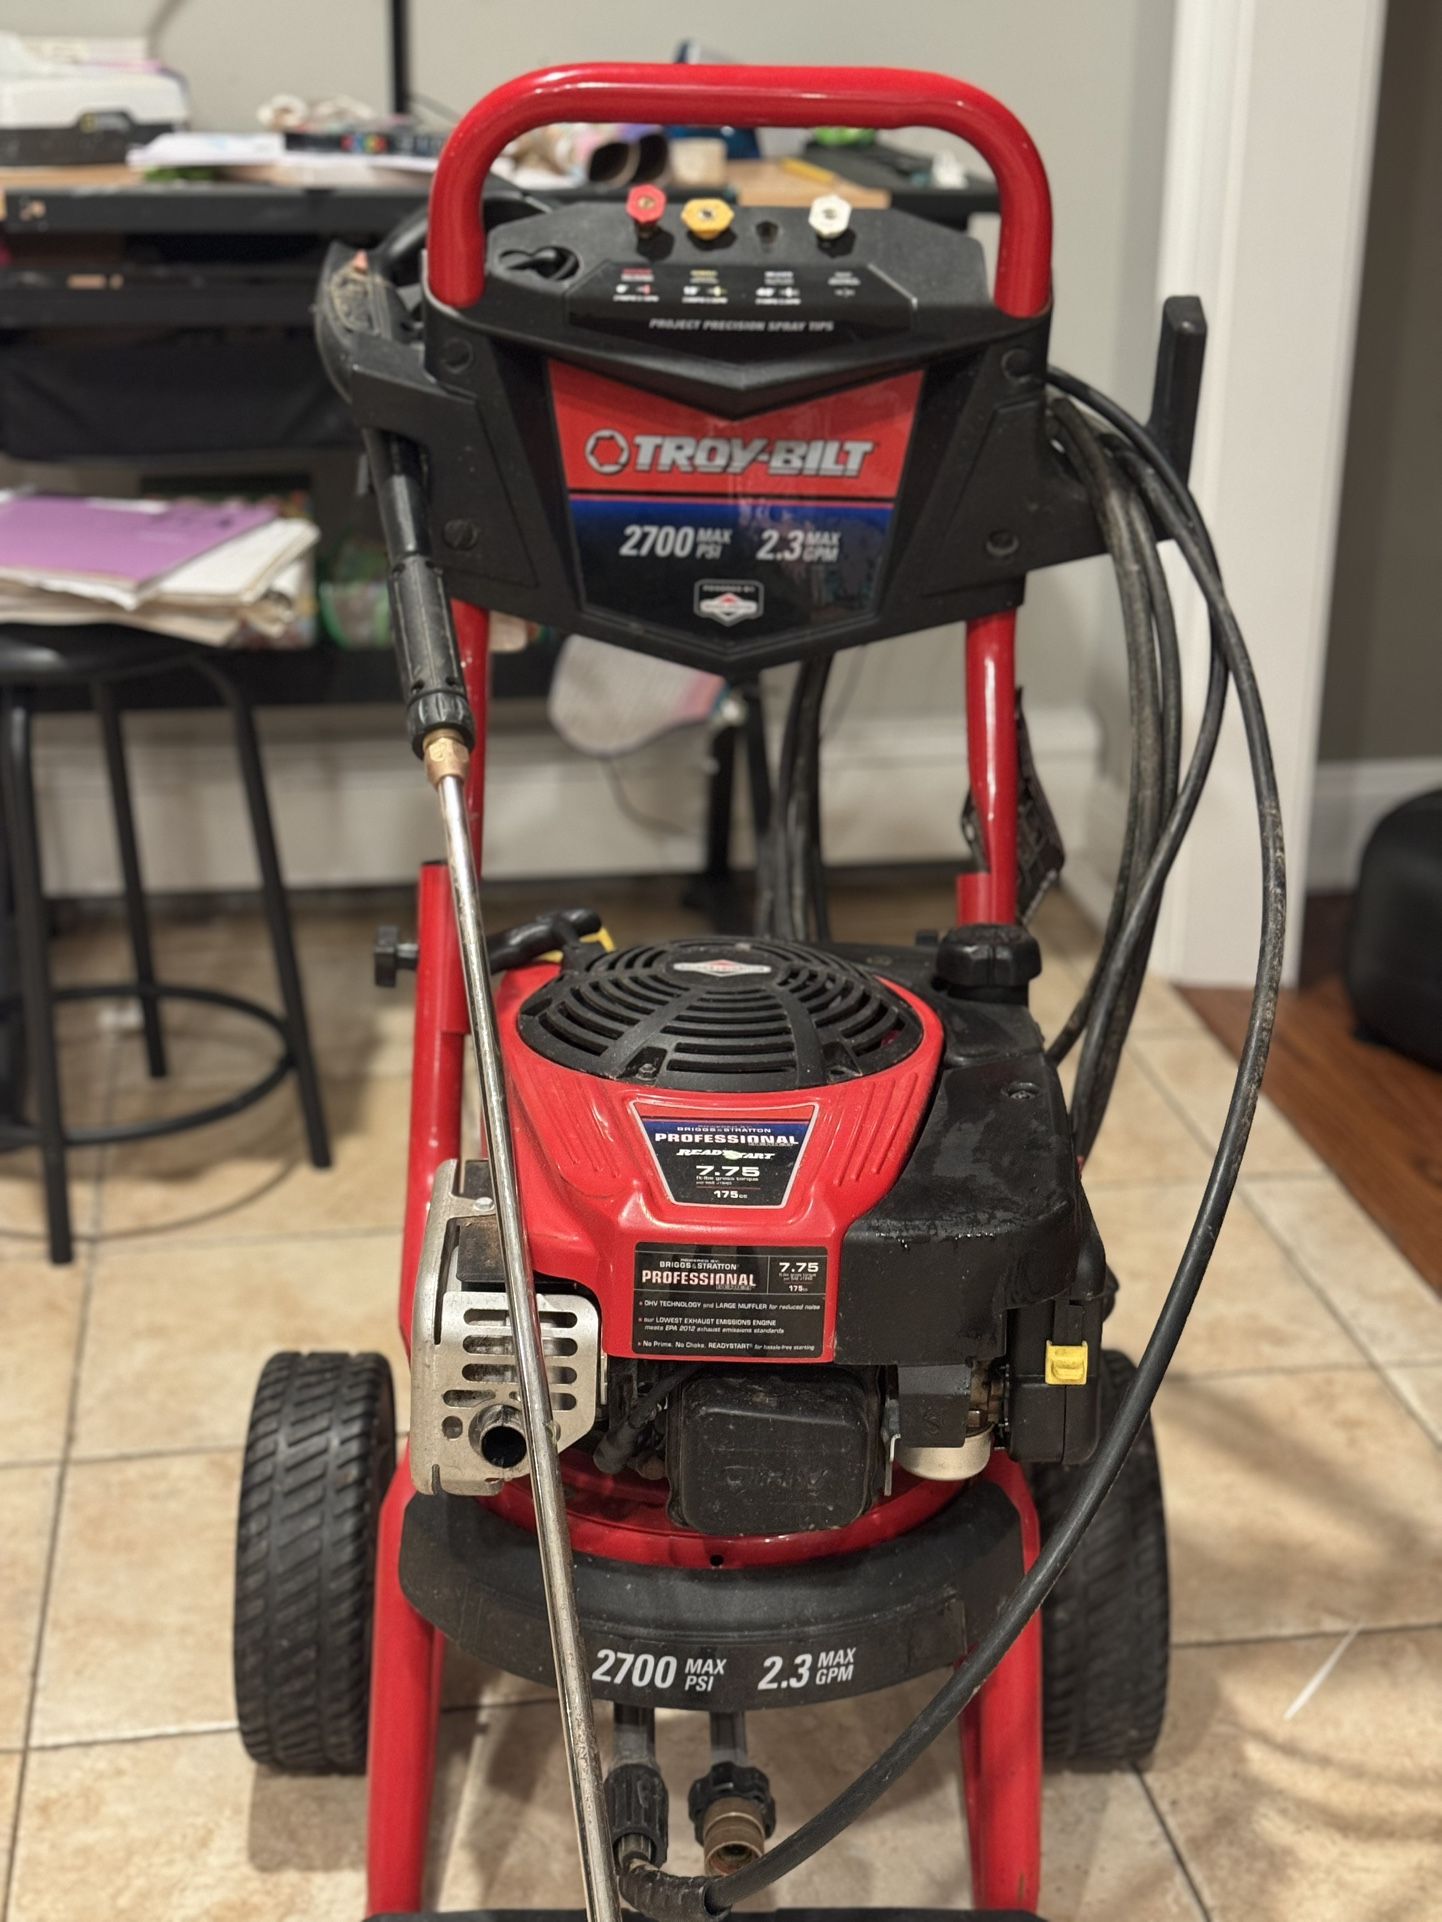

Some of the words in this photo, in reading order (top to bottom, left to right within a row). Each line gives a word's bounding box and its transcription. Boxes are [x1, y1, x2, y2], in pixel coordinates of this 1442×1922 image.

[649, 318, 701, 330] PROJECT
[702, 319, 766, 332] PRECISION
[767, 320, 806, 332] SPRAY
[808, 320, 834, 332] TIPS
[633, 435, 874, 477] TROY-BILT
[619, 525, 695, 558] 2700
[696, 528, 733, 544] MAX
[756, 528, 805, 561] 2.3
[804, 531, 842, 545] MAX
[695, 543, 722, 560] PSI
[802, 545, 839, 562] GPM
[655, 1132, 799, 1145] PROFESSIONAL
[696, 1165, 760, 1177] 7.75
[779, 1262, 819, 1272] 7.75
[641, 1270, 757, 1287] PROFESSIONAL
[660, 1300, 702, 1308] TECHNOLOGY
[737, 1302, 767, 1310] MUFFLER
[655, 1316, 683, 1324] LOWEST
[684, 1317, 714, 1325] EXHAUST
[715, 1318, 751, 1326] EMISSIONS
[752, 1319, 776, 1327] ENGINE
[817, 1647, 857, 1668] MAX
[592, 1649, 677, 1688] 2700
[685, 1658, 727, 1675] MAX
[757, 1653, 812, 1691] 2.3
[815, 1664, 854, 1685] GPM
[684, 1675, 714, 1692] PSI
